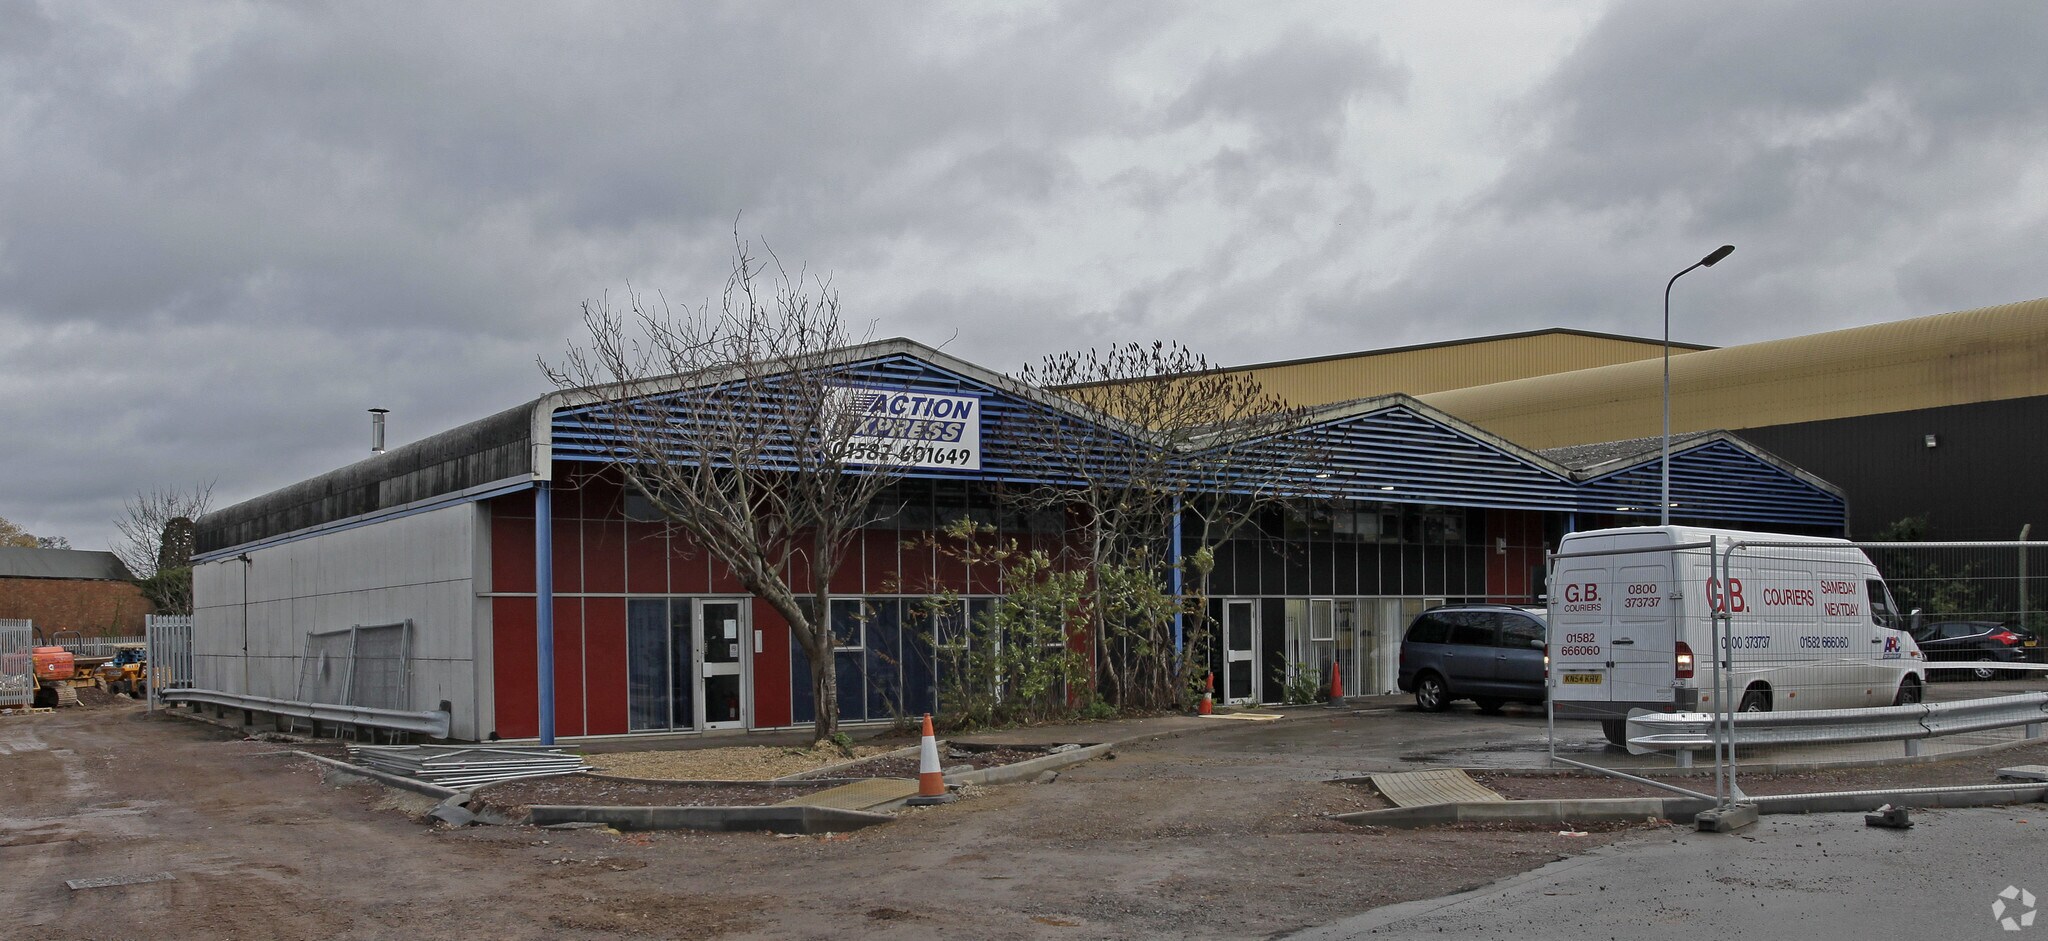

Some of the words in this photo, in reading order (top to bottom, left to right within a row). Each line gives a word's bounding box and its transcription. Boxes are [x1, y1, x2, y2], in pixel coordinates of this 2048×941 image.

[868, 393, 973, 419] ACTION
[1564, 583, 1602, 602] G.B.
[1627, 584, 1657, 595] 0800
[1820, 580, 1857, 595] SAMEDAY
[1624, 597, 1661, 608] 373737
[1763, 588, 1815, 607] COURIERS
[1564, 603, 1602, 613] COURIERS
[1824, 602, 1860, 617] NEXTDAY
[1566, 633, 1595, 643] 01582
[1721, 636, 1743, 650] 000
[1744, 636, 1771, 649] 373737
[1799, 636, 1821, 649] 01582
[1821, 636, 1849, 649] 666060
[1884, 636, 1901, 653] APC
[1561, 646, 1600, 656] 666060
